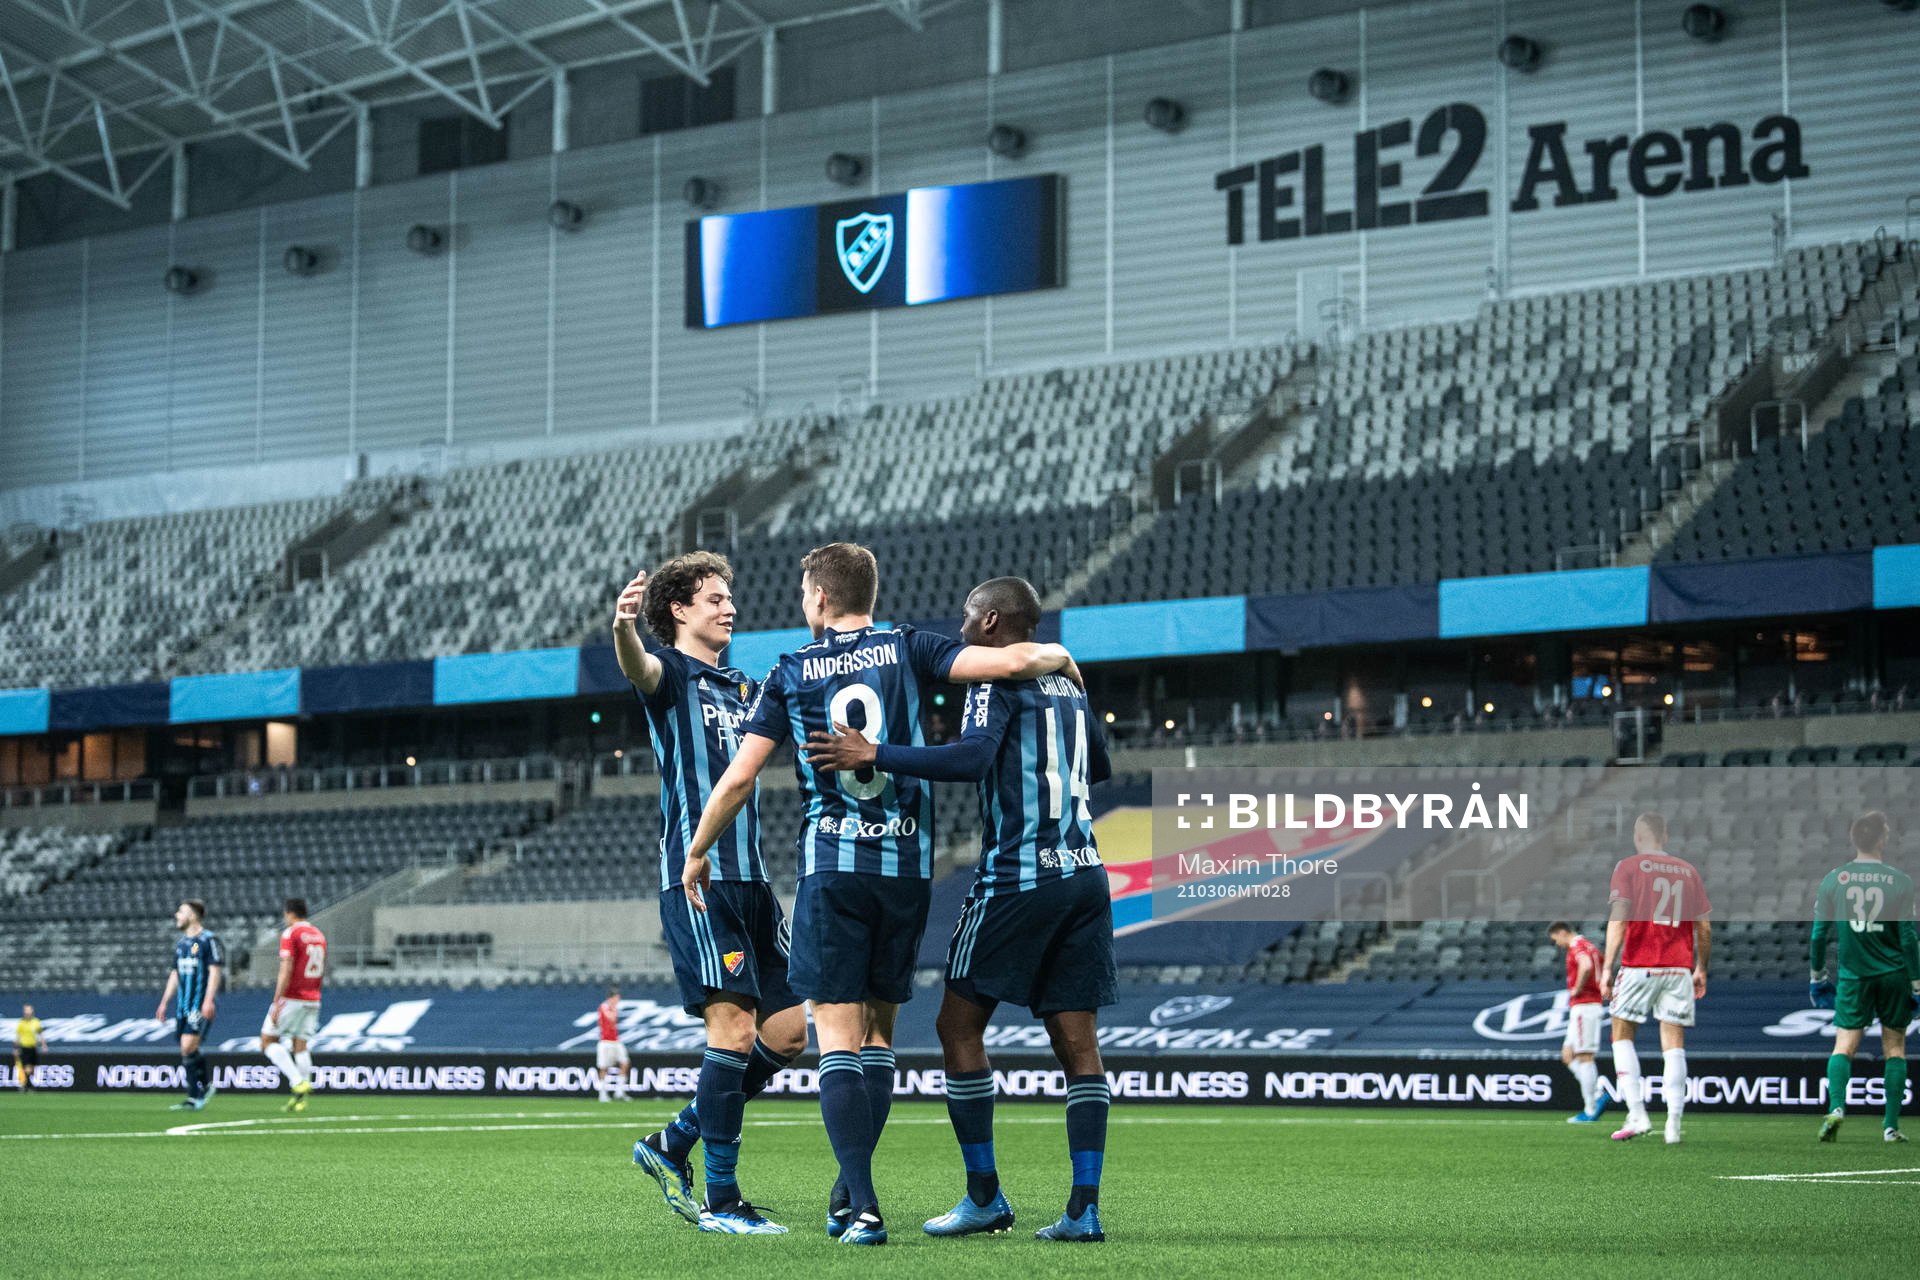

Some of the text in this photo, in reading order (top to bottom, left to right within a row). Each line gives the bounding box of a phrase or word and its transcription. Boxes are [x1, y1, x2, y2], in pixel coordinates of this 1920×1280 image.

[1214, 102, 1811, 245] TELE2 Arena
[802, 643, 898, 681] ANDERSSON
[1045, 707, 1093, 821] 14
[837, 816, 917, 838] FXORO
[1850, 872, 1894, 885] REDEYE
[1653, 877, 1684, 928] 21
[1845, 886, 1885, 933] 32
[1265, 1072, 1553, 1101] NORDICWELLNESS
